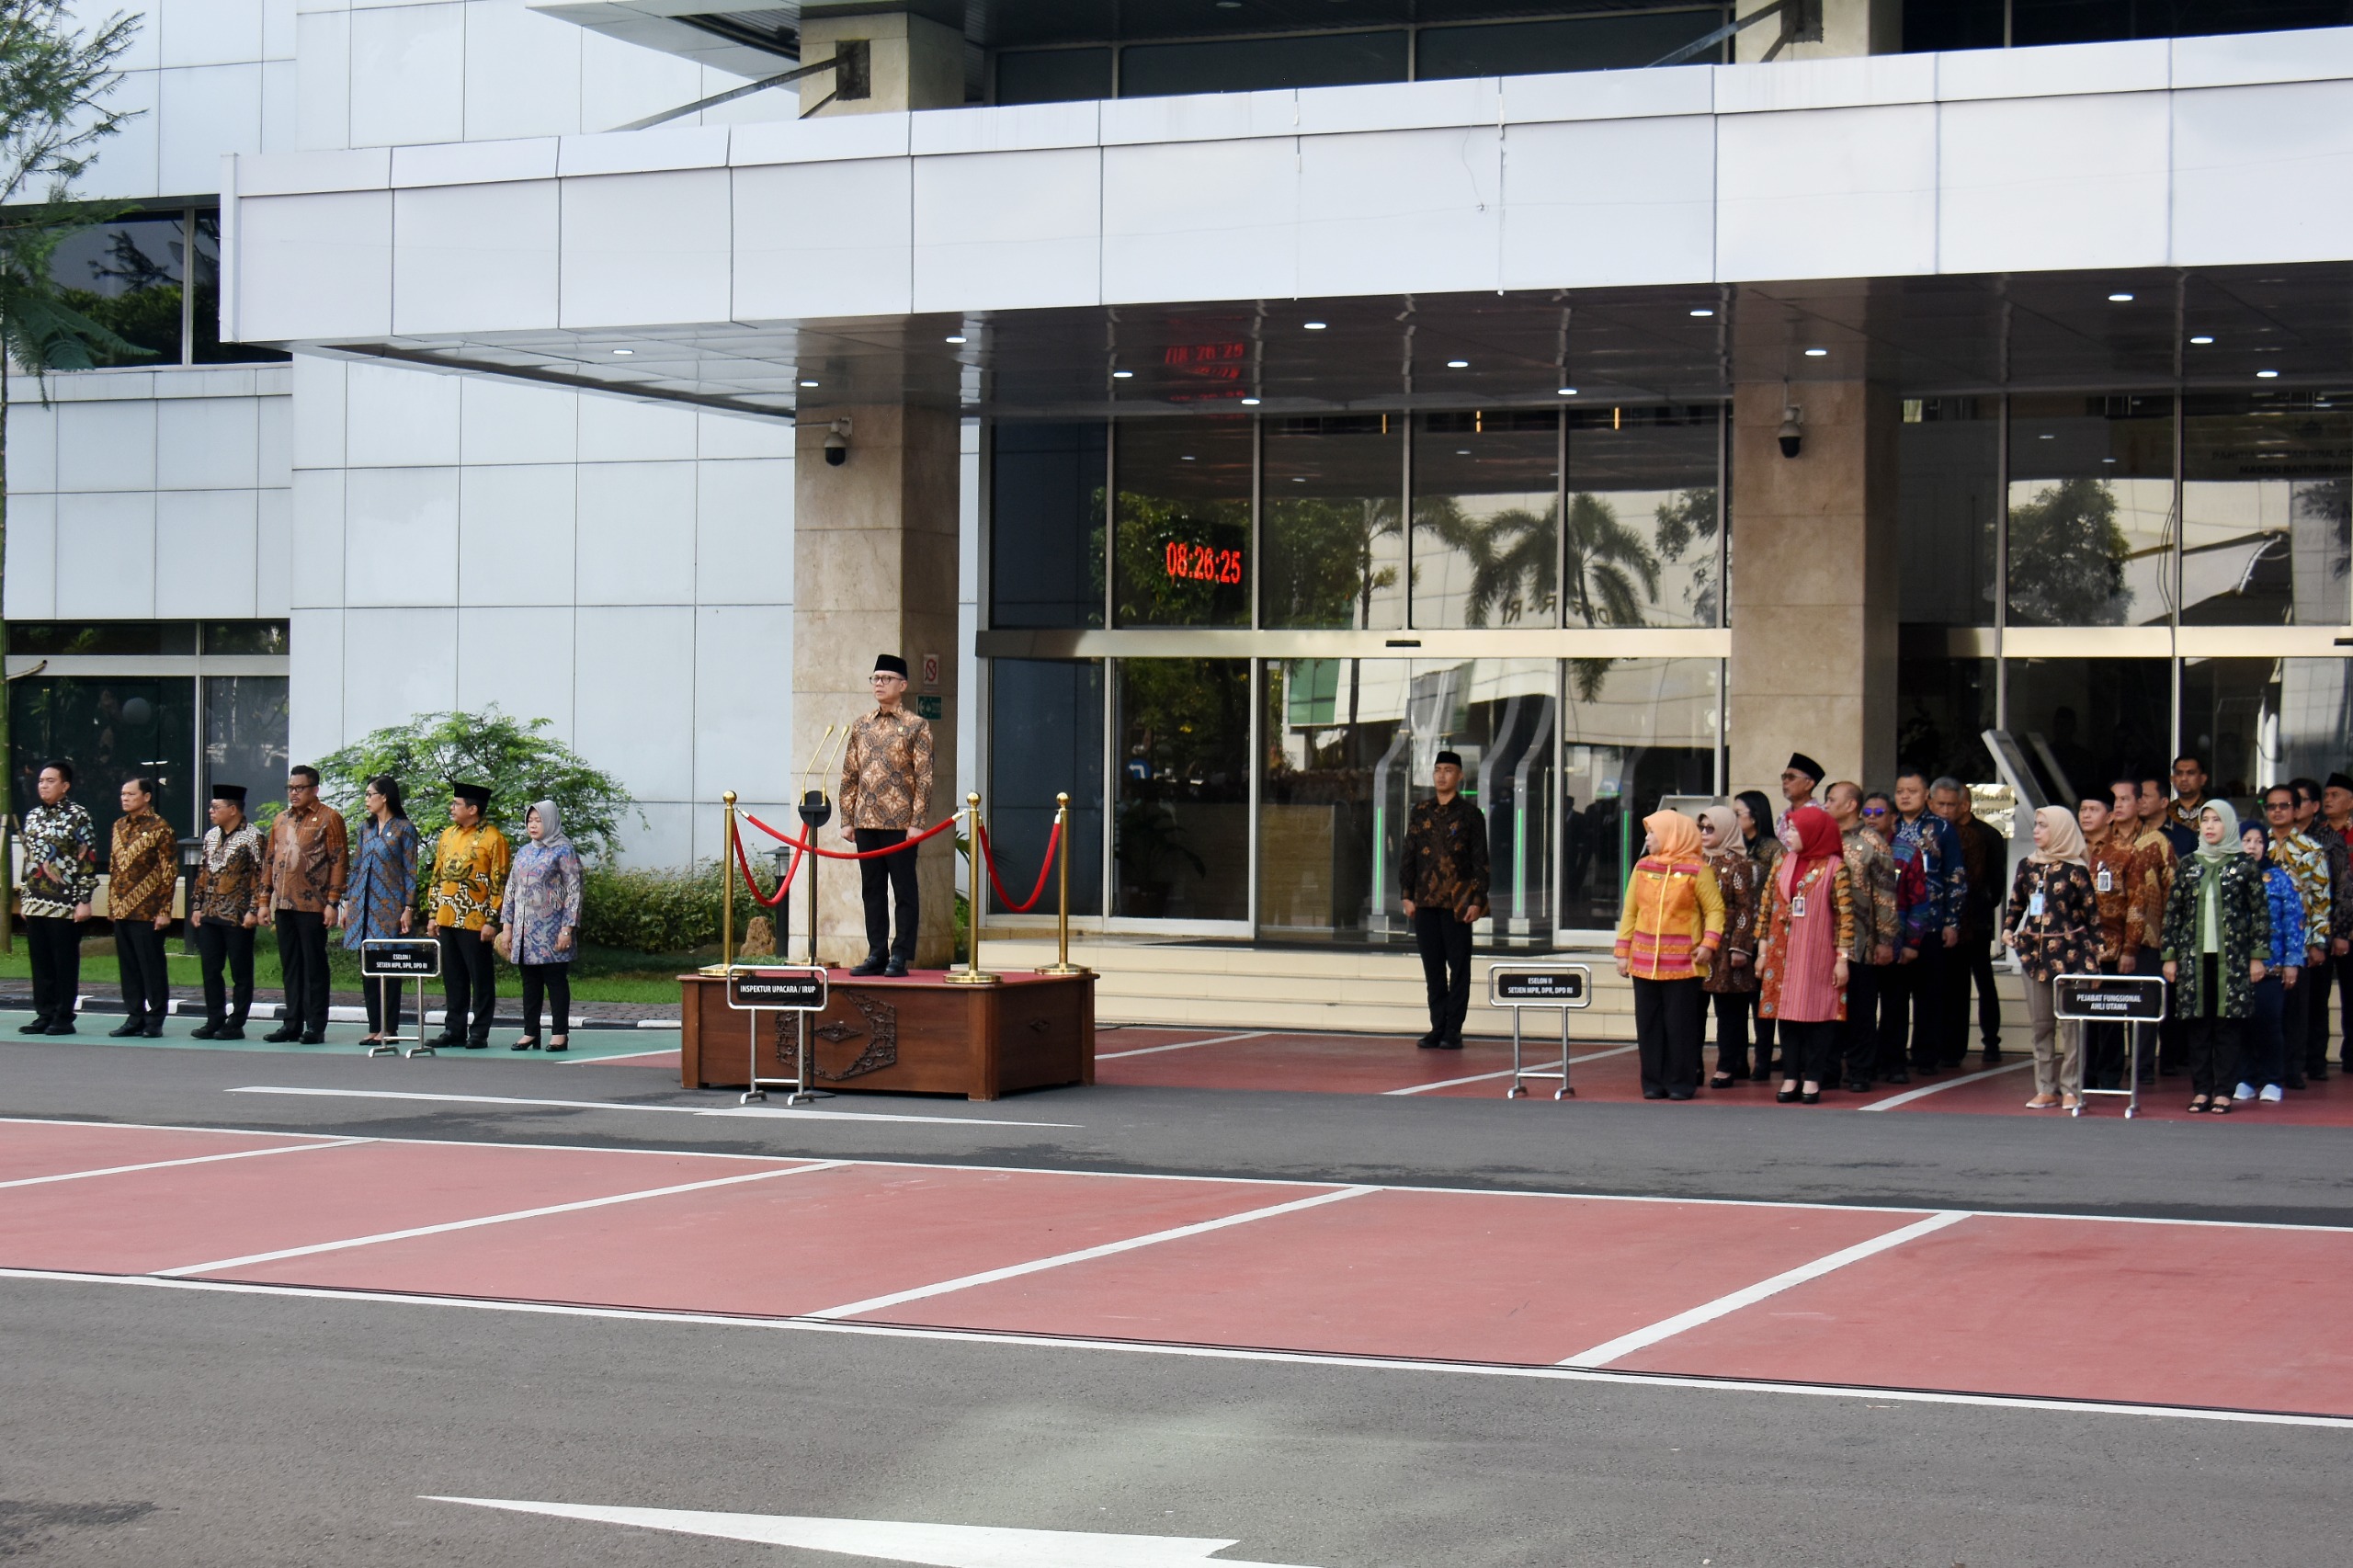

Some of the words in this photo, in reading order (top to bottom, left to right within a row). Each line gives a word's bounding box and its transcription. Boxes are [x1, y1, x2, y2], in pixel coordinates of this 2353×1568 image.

[1166, 541, 1242, 584] 08:26:25
[2076, 994, 2102, 1002] PEJABAT
[2103, 994, 2142, 1003] FUNGSIONAL
